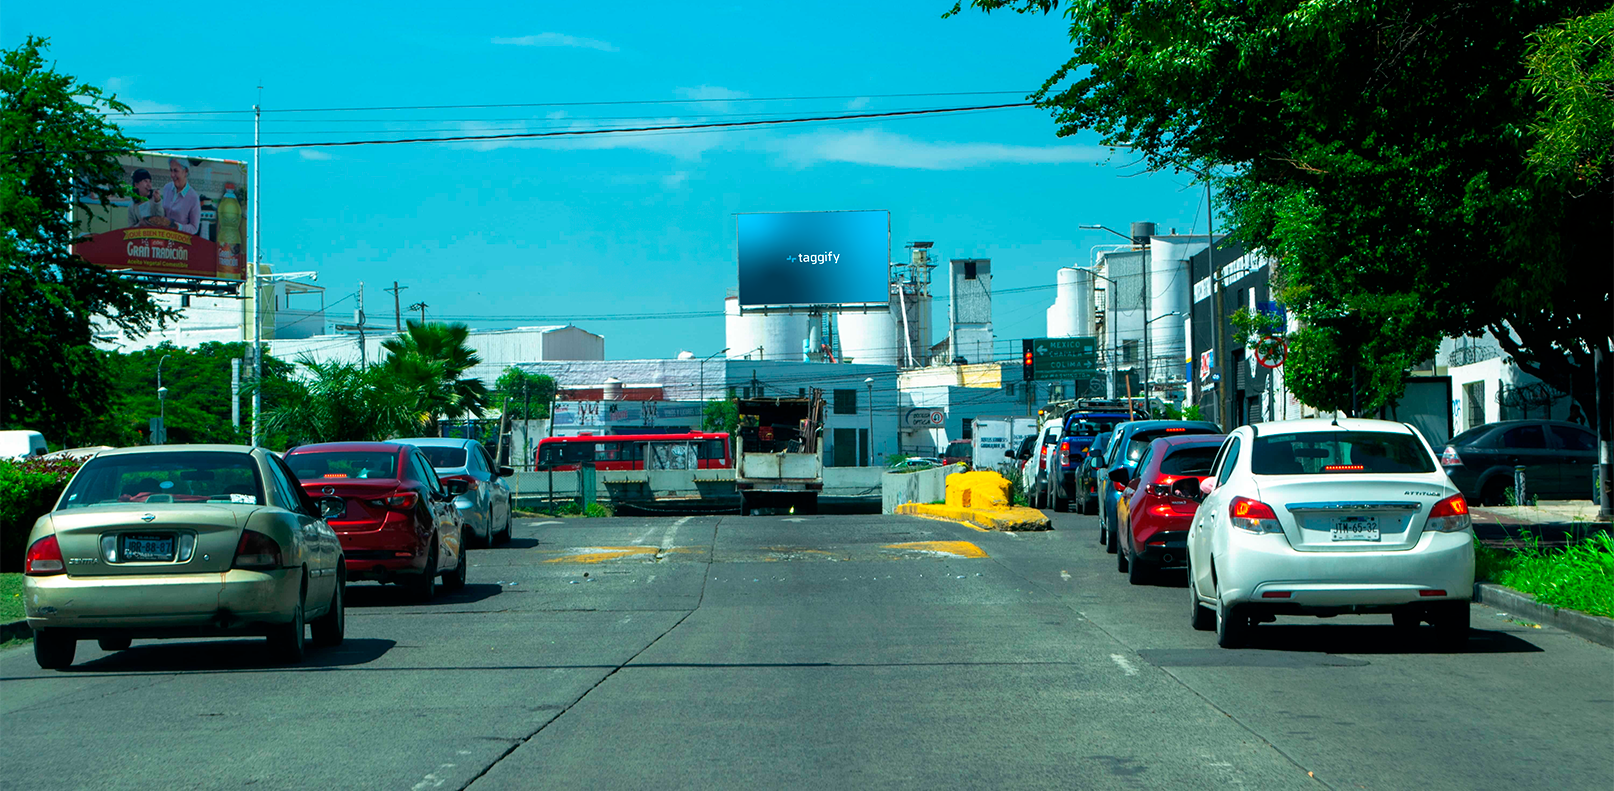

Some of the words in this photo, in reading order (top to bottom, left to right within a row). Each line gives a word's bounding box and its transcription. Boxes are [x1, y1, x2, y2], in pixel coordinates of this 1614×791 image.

[798, 250, 840, 265] taggify
[1050, 361, 1082, 369] COLIMA
[69, 558, 99, 566] SENTRA
